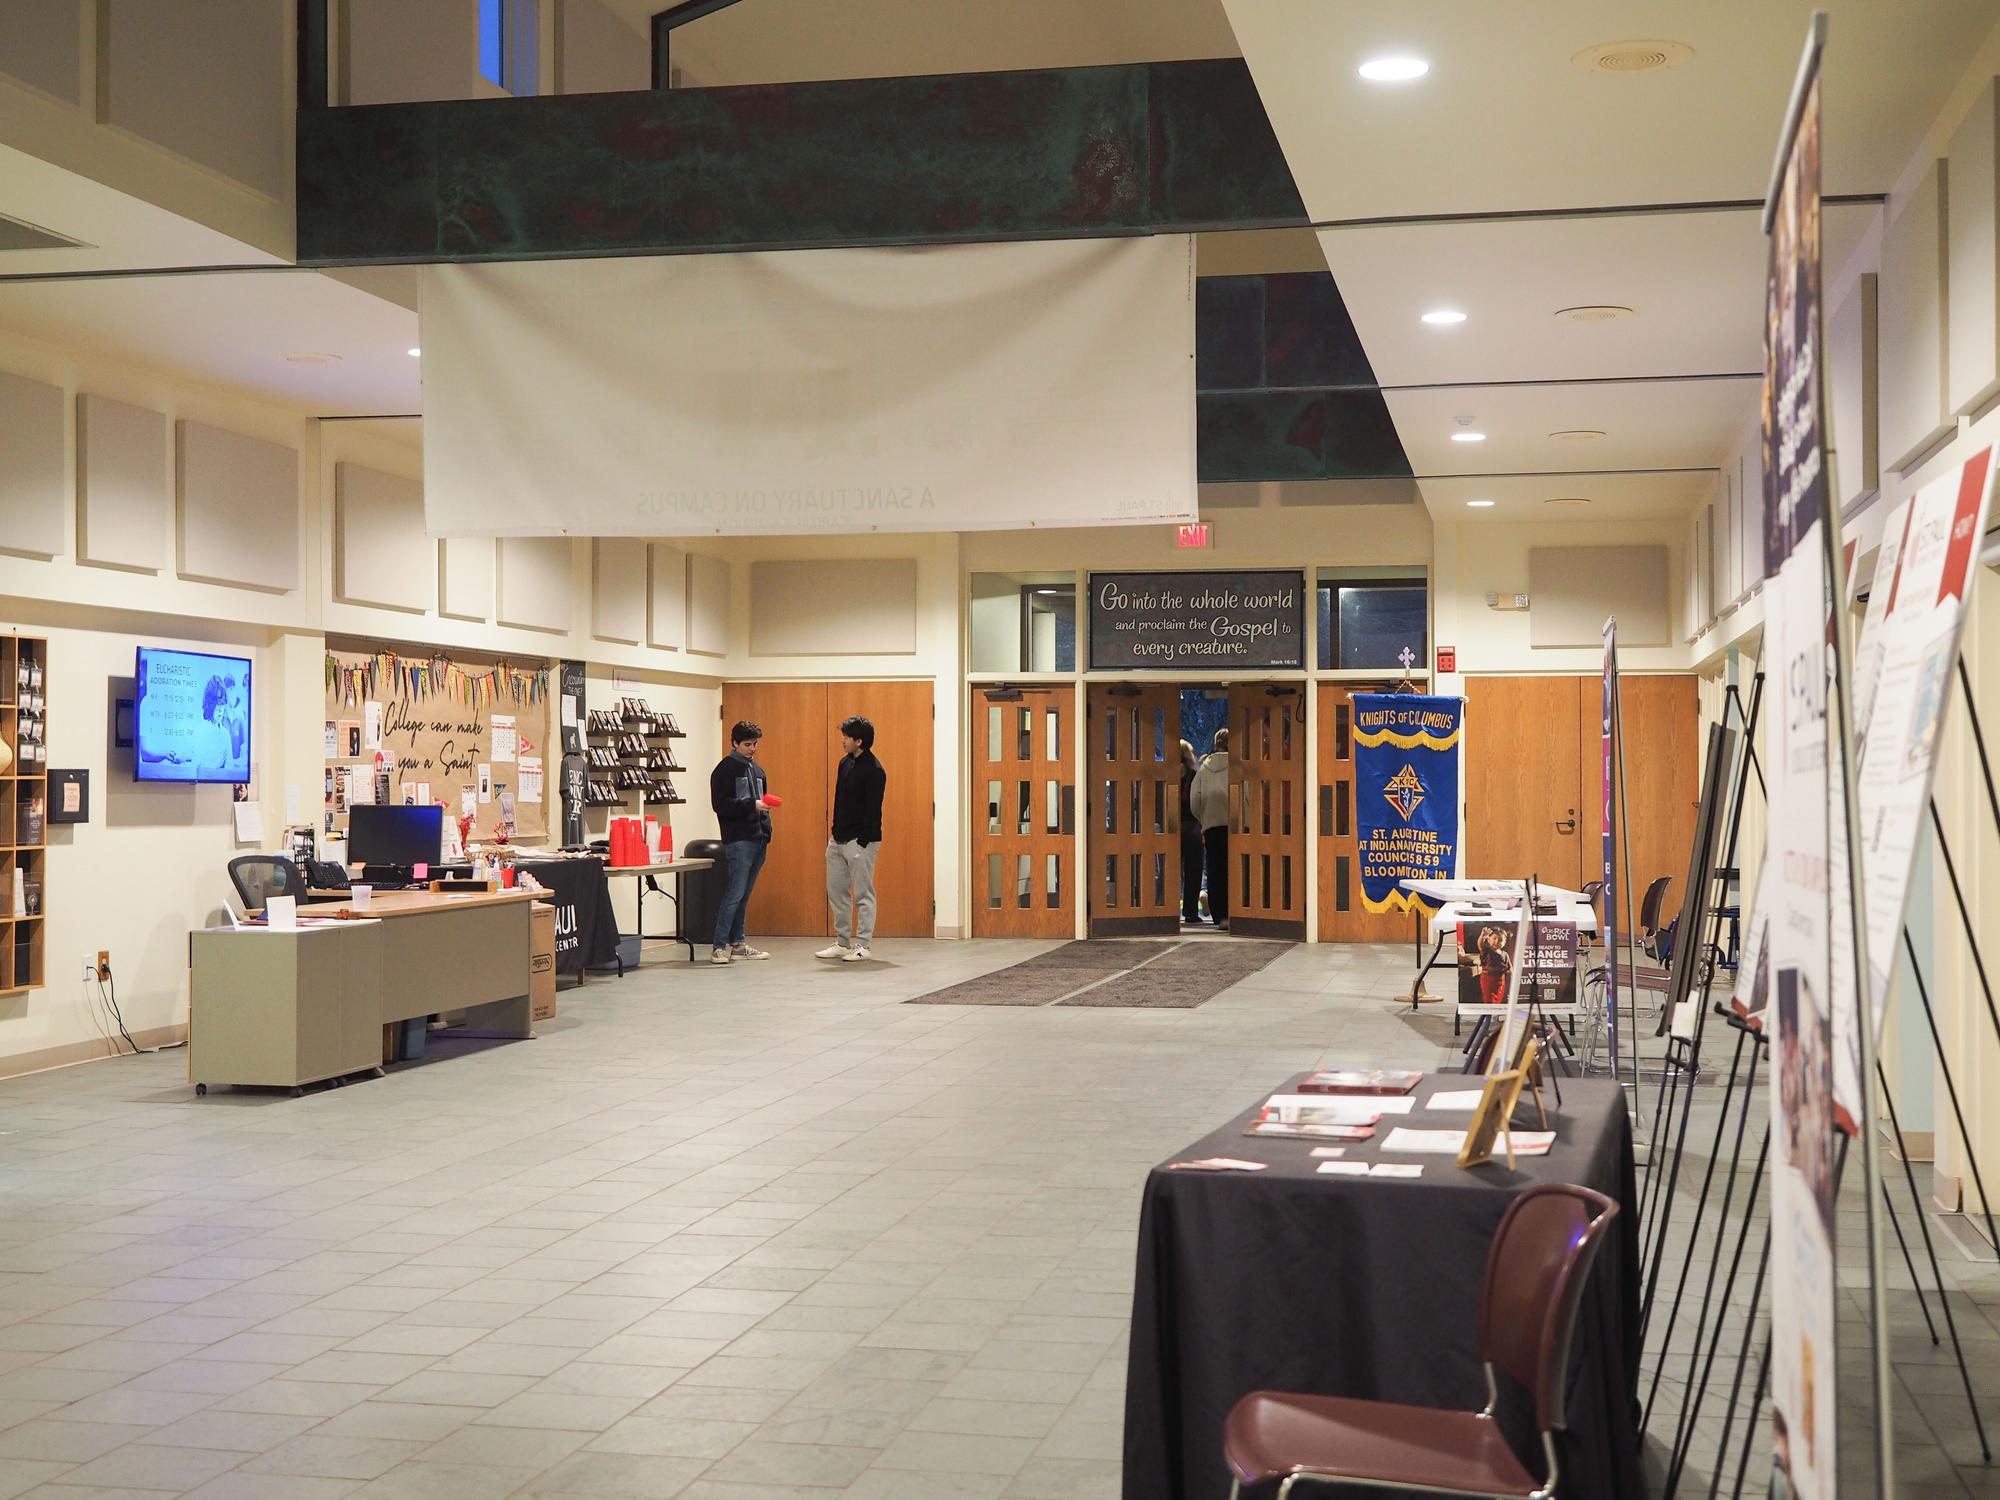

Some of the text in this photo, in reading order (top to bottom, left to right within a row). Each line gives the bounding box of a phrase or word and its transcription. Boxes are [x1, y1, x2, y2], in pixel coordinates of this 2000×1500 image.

[1178, 525, 1208, 547] EXIT
[1100, 582, 1293, 610] Go into the whole world
[1115, 615, 1291, 643] and proclaim the Gospel to
[1133, 639, 1248, 660] every creature.
[385, 698, 425, 748] College
[431, 721, 452, 733] can
[457, 708, 483, 736] make
[1360, 710, 1396, 727] KNIGHTS
[1398, 712, 1408, 723] OF
[398, 757, 419, 786] you
[424, 759, 433, 769] a
[1372, 829, 1387, 839] ST.
[1359, 840, 1367, 850] AT
[1522, 959, 1553, 967] LIVES
[1523, 950, 1569, 958] CHANGE
